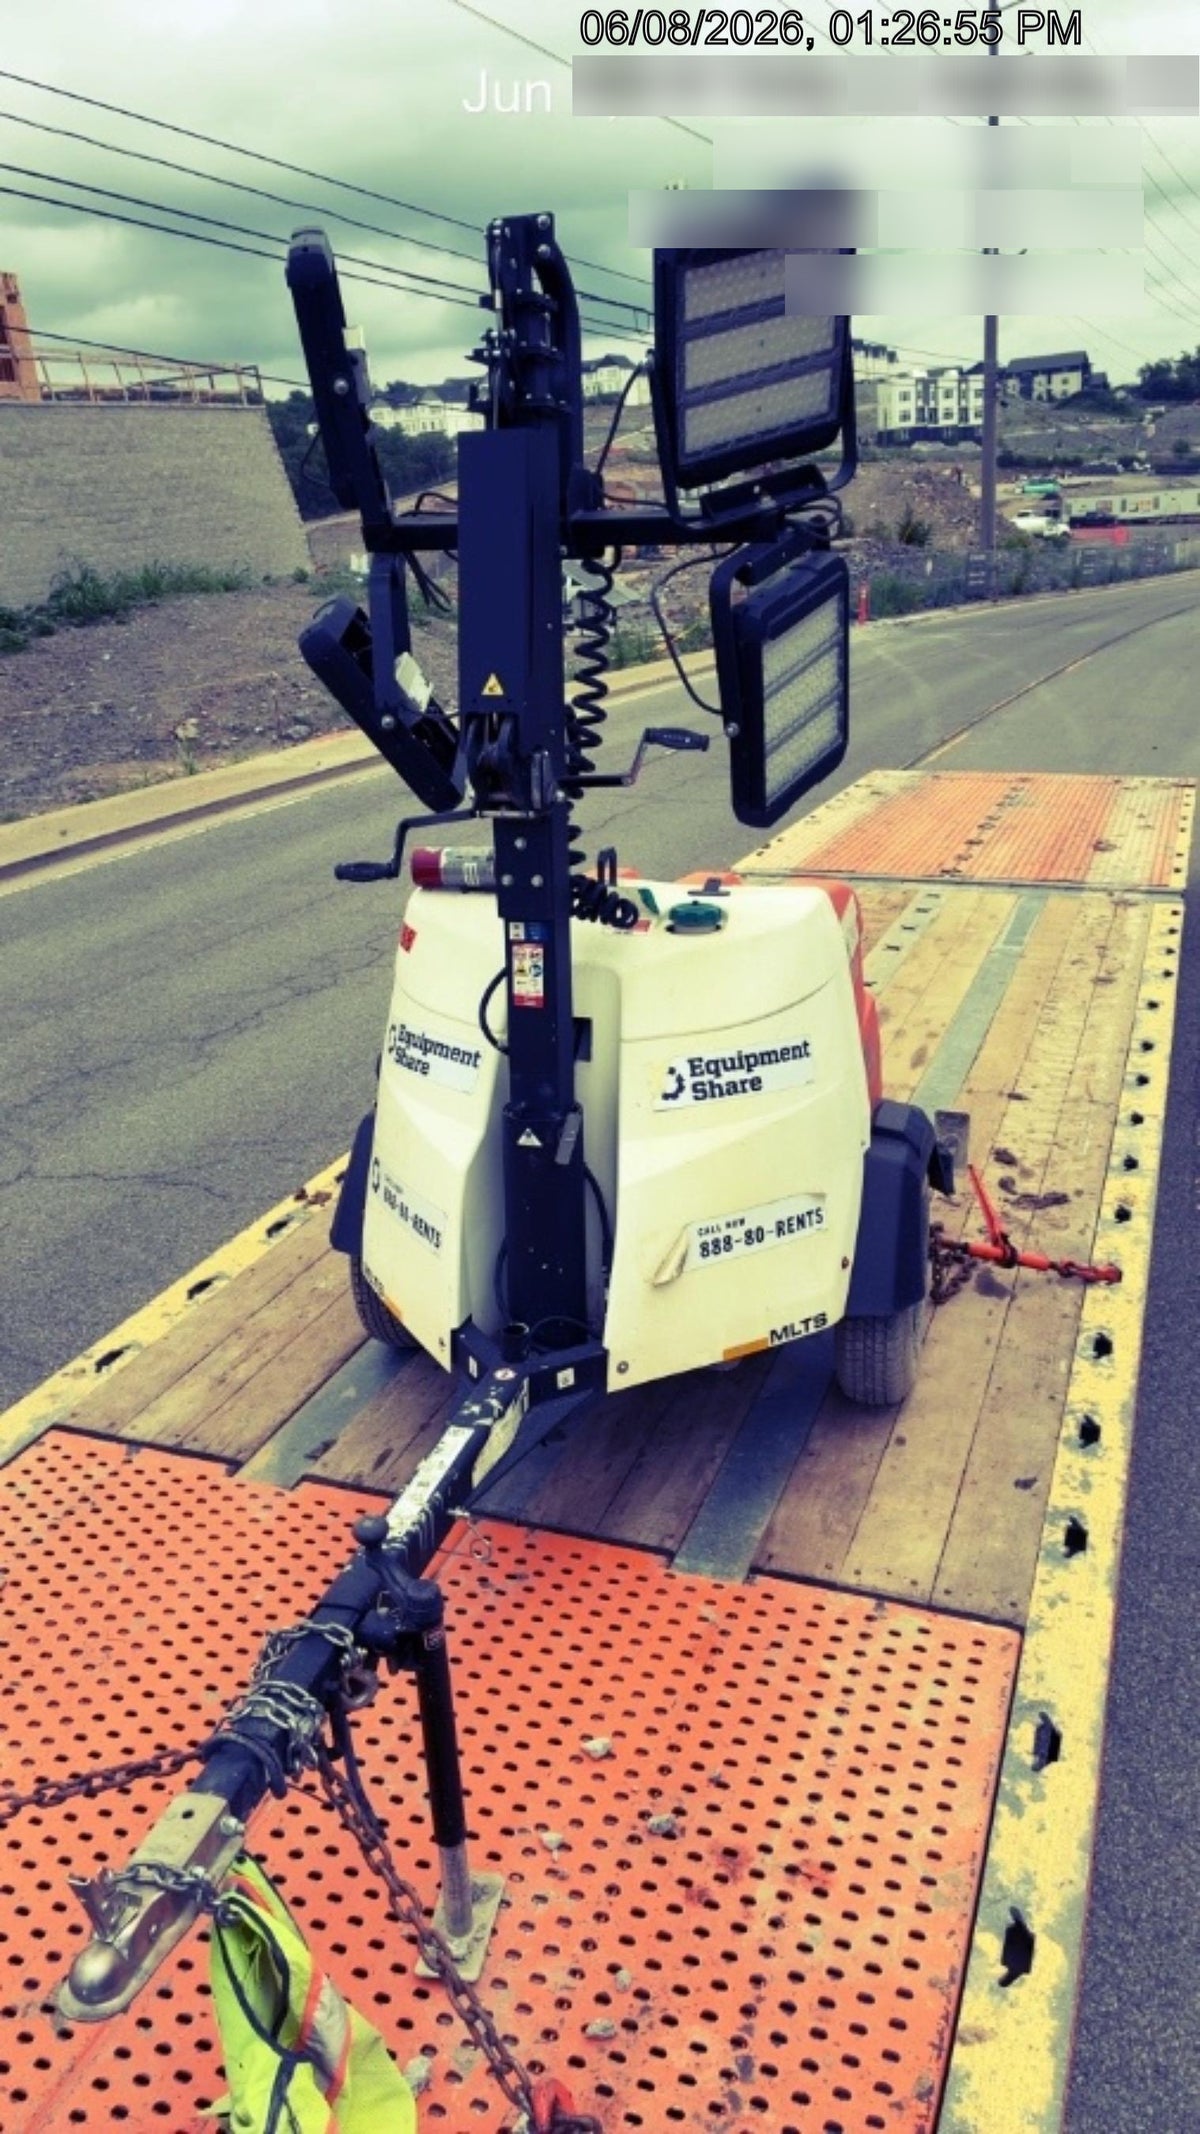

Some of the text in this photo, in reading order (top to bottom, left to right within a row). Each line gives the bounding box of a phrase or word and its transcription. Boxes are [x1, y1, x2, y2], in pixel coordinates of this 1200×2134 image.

[394, 1046, 430, 1075] Share
[398, 1023, 481, 1068] Equipment
[687, 1040, 810, 1078] Equipment
[691, 1076, 762, 1101] Share
[697, 1217, 746, 1236] CALL NOW
[699, 1207, 824, 1258] 888-80-RENTS
[770, 1312, 828, 1345] MLTS
